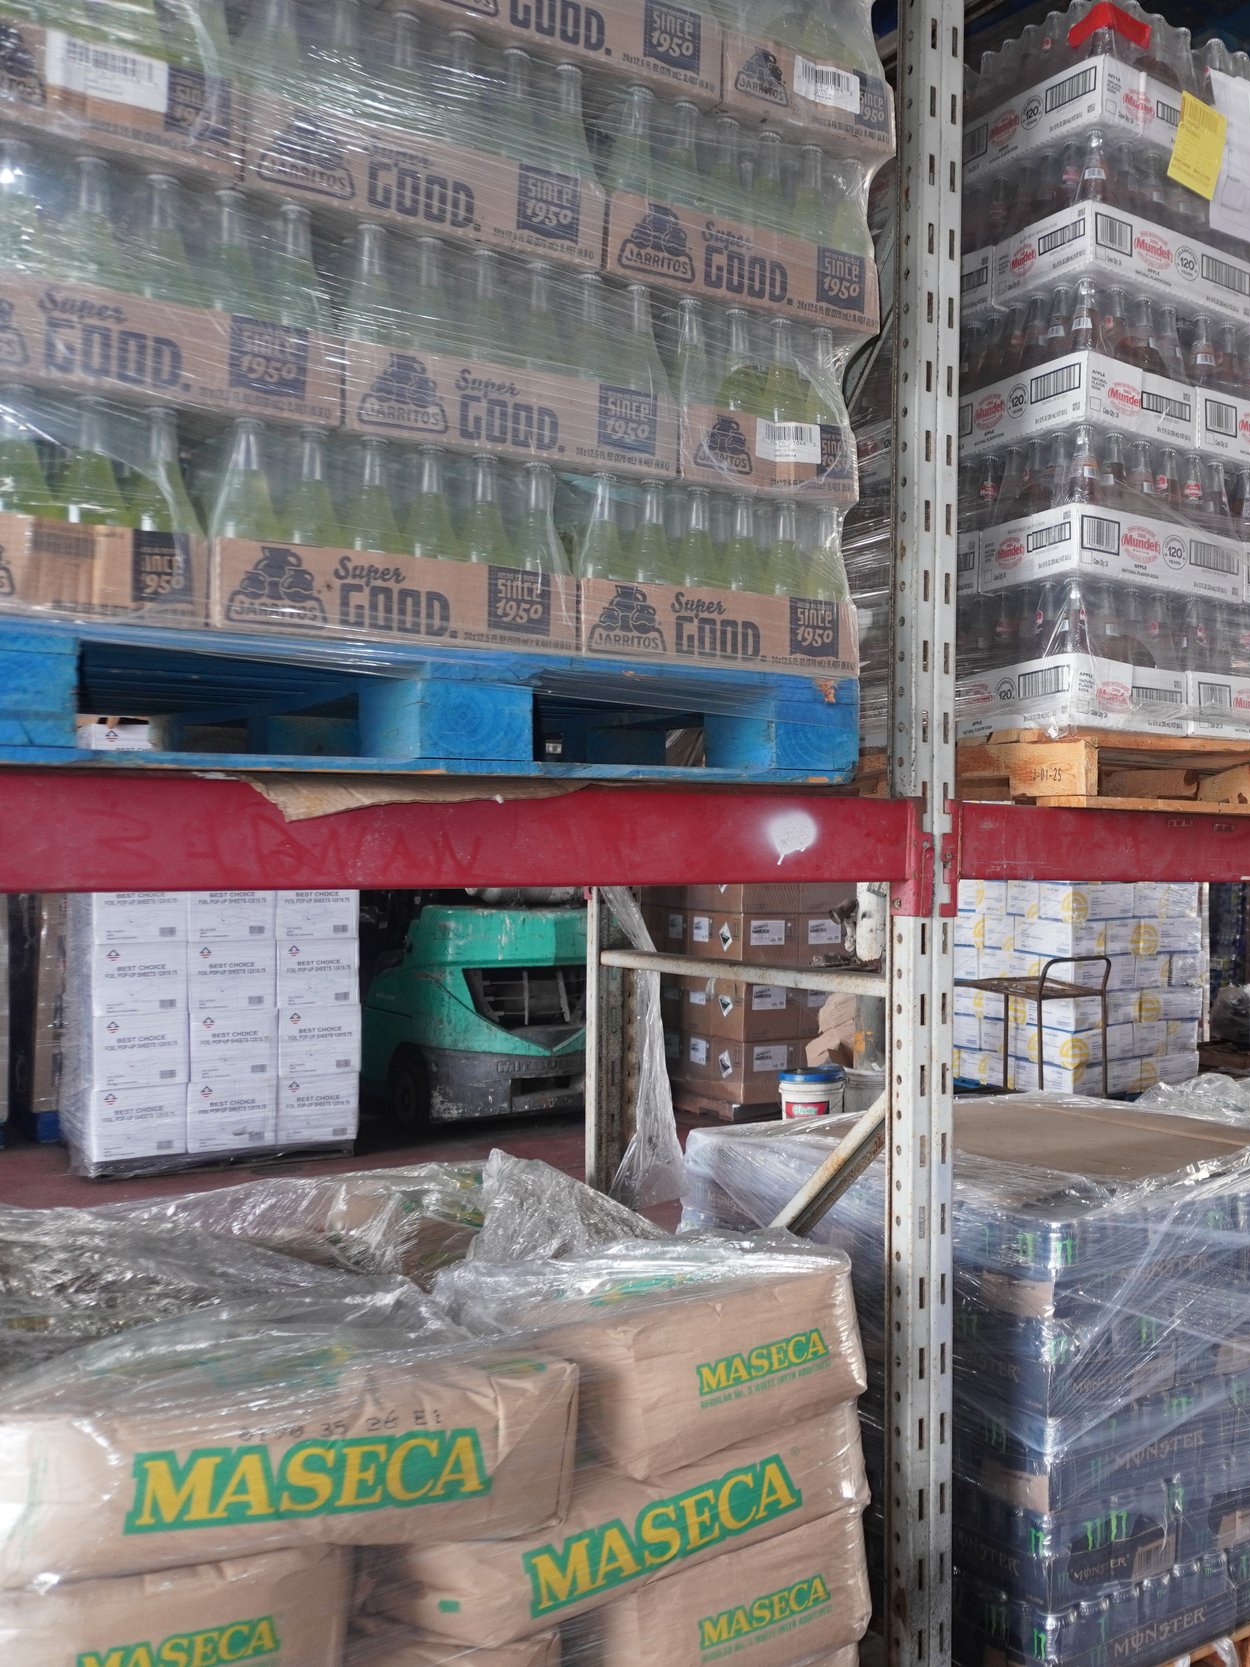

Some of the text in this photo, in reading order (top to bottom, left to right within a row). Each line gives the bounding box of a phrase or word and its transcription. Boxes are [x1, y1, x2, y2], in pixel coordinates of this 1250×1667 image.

[652, 11, 694, 41] SINCE
[651, 31, 694, 57] 1950
[739, 77, 784, 102] JARRITOS
[1025, 105, 1040, 121] 120
[368, 160, 481, 232] GOOD.
[527, 177, 573, 206] SINCE
[526, 200, 573, 227] 1950
[702, 221, 754, 250] Super
[625, 249, 689, 276] JARRITOS
[1134, 236, 1174, 263] Mundet
[704, 246, 793, 306] GOOD.
[824, 259, 860, 282] SINCE
[1180, 256, 1195, 271] 120
[823, 276, 860, 300] 1950
[44, 317, 190, 393] GOOD.
[240, 354, 297, 383] 1950
[455, 368, 520, 399] Super
[366, 401, 441, 426] JARRITOS
[606, 399, 649, 421] SINCE
[975, 400, 1005, 421] Mundet
[1011, 394, 1024, 408] 120
[460, 394, 566, 453] GOOD.
[606, 417, 649, 441] 1950
[1122, 533, 1161, 556] Mundet
[1167, 546, 1183, 559] 120
[333, 555, 406, 586] Super
[1134, 563, 1147, 571] APPLE
[498, 580, 542, 600] SINCE
[339, 582, 458, 640] GOOD.
[496, 600, 542, 625] 1950
[671, 591, 726, 619] Super
[798, 607, 832, 628] SINCE
[597, 632, 660, 650] JARRITOS
[675, 616, 767, 663] GOOD.
[797, 626, 833, 647] 1950
[699, 1331, 827, 1393] MASECA
[1113, 1429, 1206, 1471] MONSTER
[135, 1435, 486, 1526] MASECA
[531, 1461, 797, 1610] MASECA
[702, 1577, 828, 1647] MASECA
[1113, 1605, 1207, 1658] MONSTER
